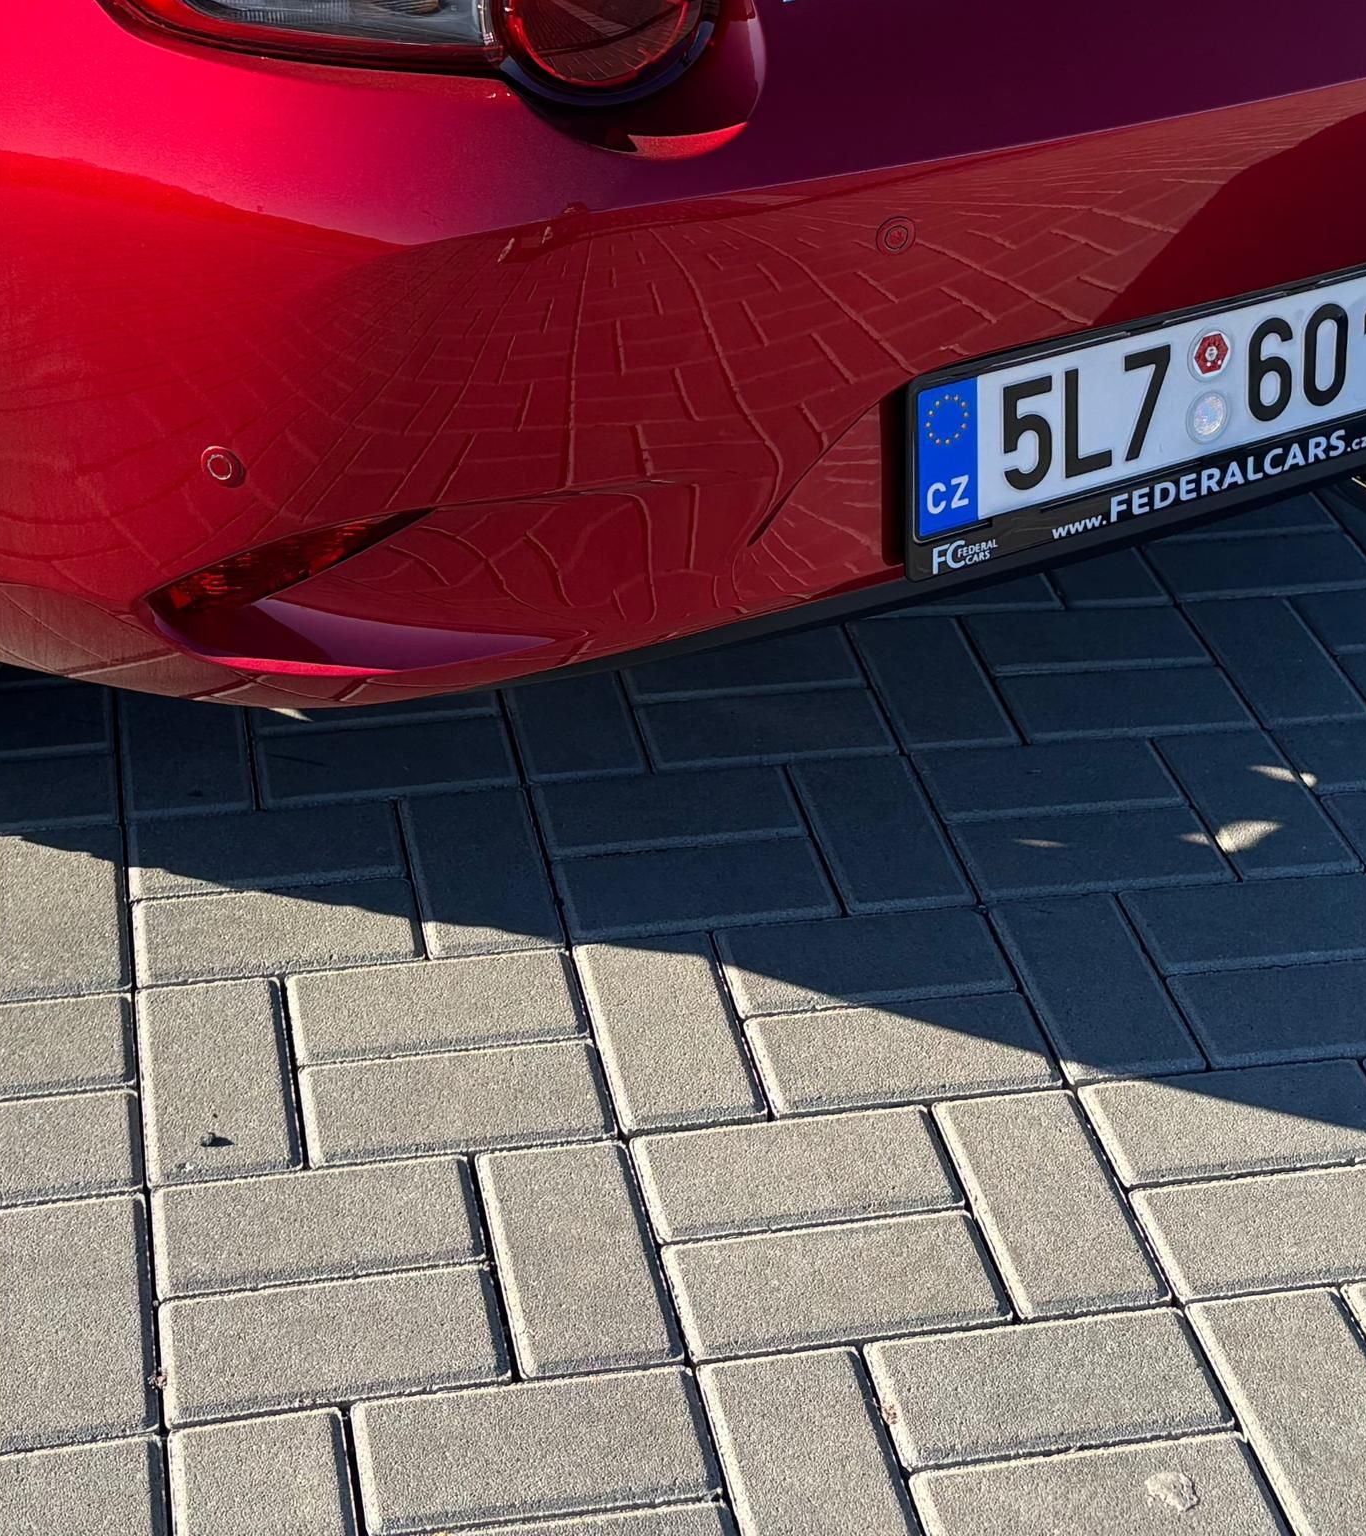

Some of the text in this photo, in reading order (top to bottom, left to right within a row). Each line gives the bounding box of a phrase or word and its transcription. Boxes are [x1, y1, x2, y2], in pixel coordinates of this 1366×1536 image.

[1003, 344, 1171, 491] 5L7
[926, 474, 970, 514] CZ
[932, 539, 967, 575] FC
[957, 538, 998, 558] FEDERAL
[965, 550, 991, 565] CARS
